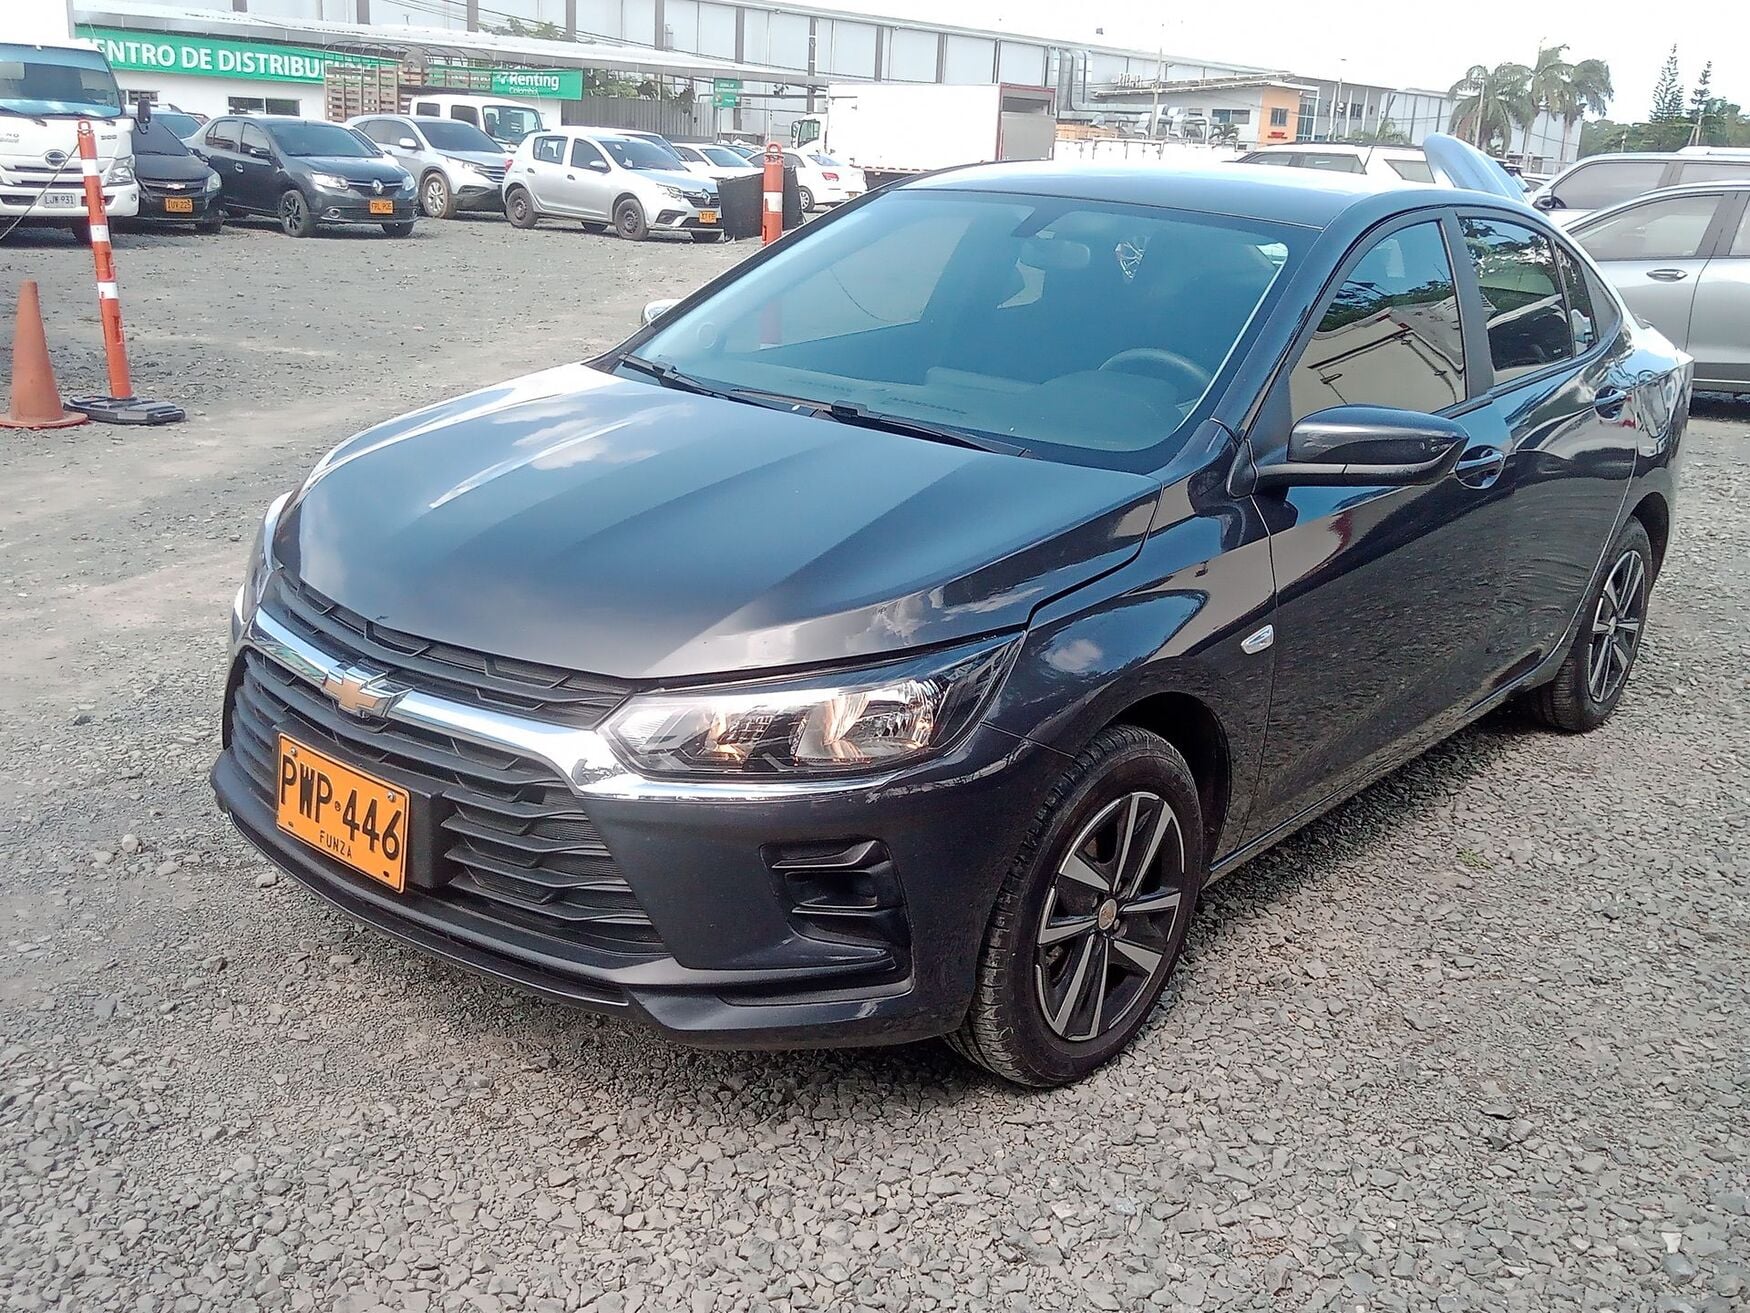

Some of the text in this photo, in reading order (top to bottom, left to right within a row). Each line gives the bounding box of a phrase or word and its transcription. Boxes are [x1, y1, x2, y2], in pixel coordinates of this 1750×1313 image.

[80, 38, 177, 67] ENTRO
[181, 46, 213, 70] DE
[509, 71, 560, 91] Renting
[60, 195, 74, 205] 931
[280, 754, 402, 861] PWP 446
[319, 829, 353, 860] FUNZA
